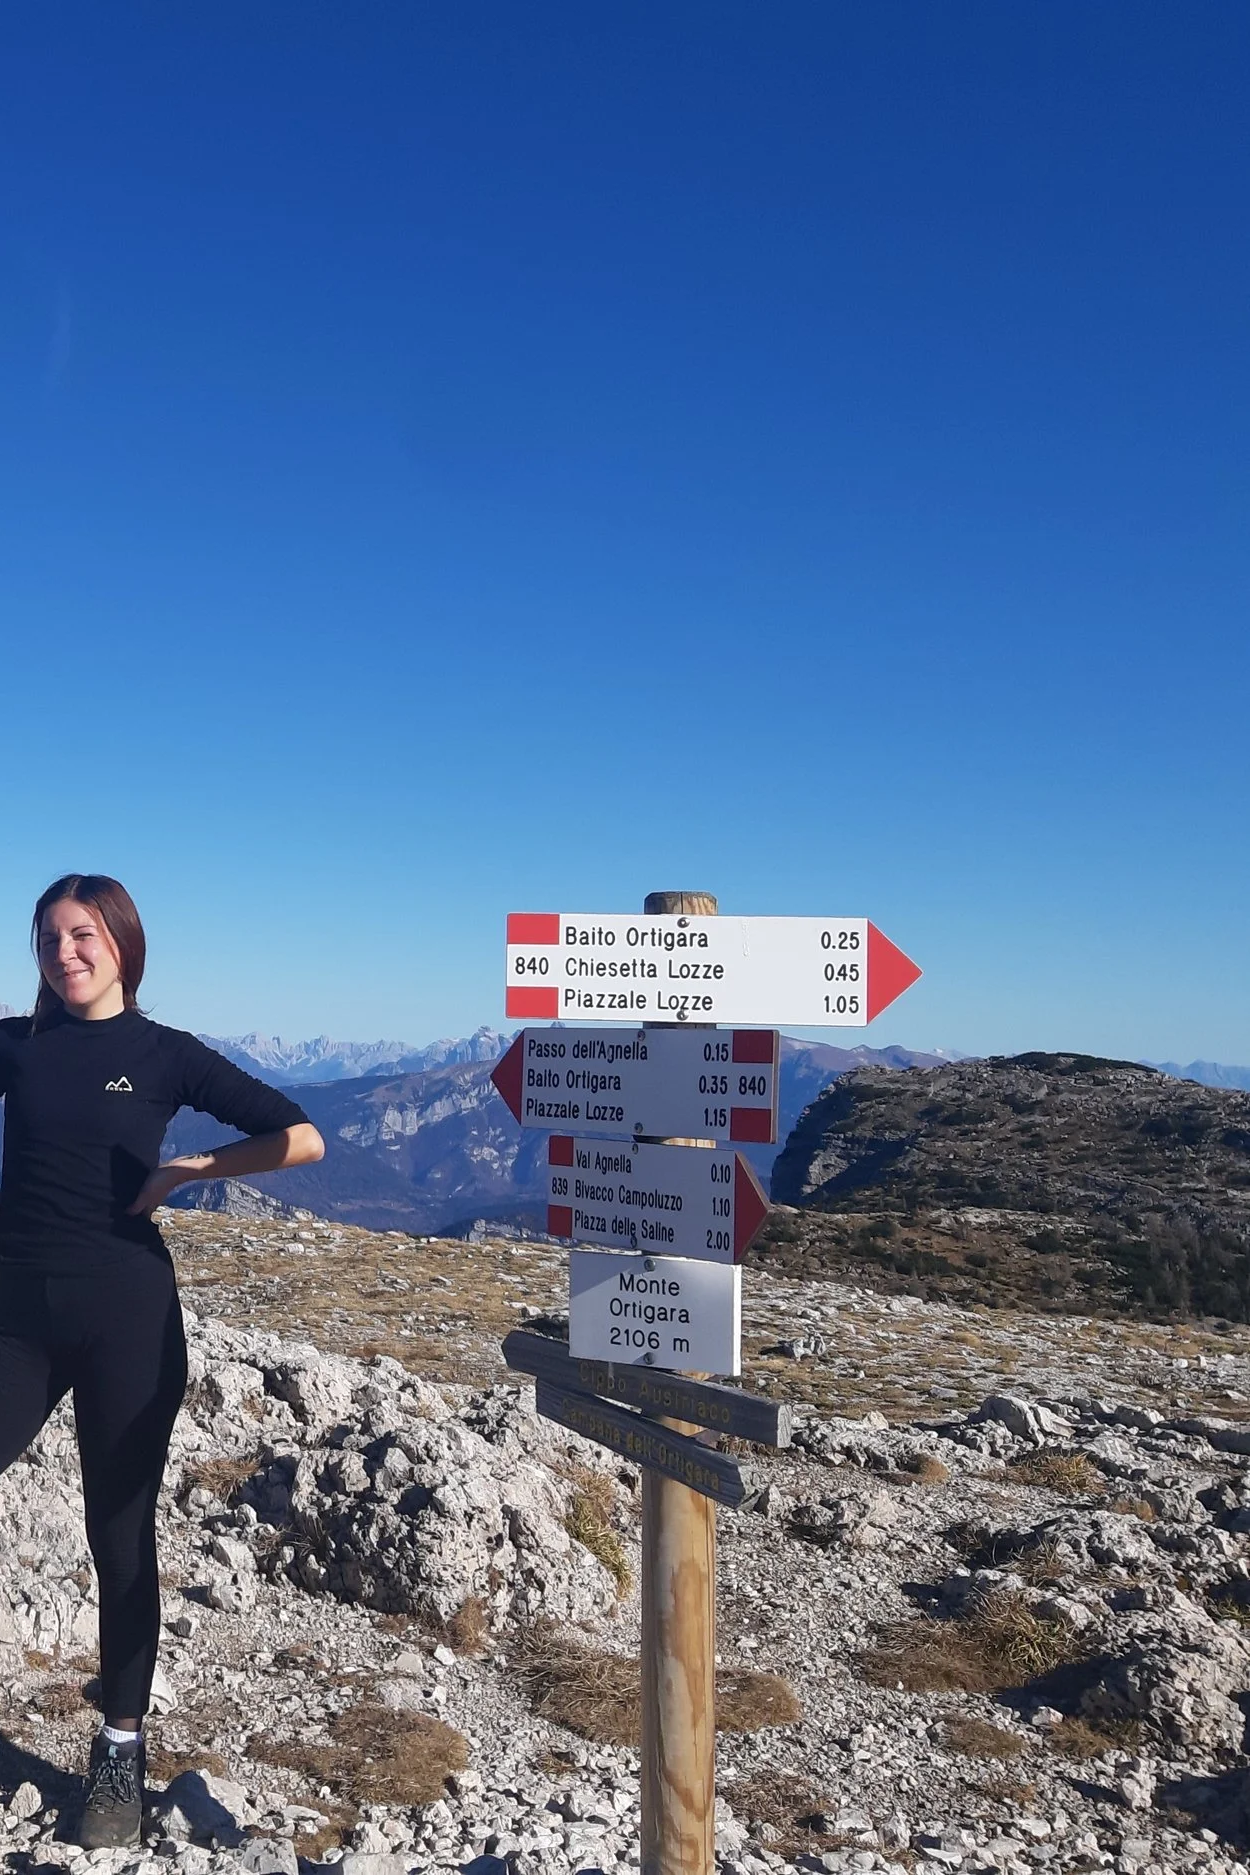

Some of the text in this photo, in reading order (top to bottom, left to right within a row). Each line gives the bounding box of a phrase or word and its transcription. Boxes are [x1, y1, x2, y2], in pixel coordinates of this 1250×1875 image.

[565, 927, 860, 952] Baito Ortigara 0.25
[515, 957, 860, 982] 840 Chiesetta Lozze 0.45
[564, 988, 860, 1014] Piazzale Lozze 1.05
[528, 1039, 729, 1063] Passo dell'Agnella 0.15
[527, 1068, 766, 1096] Baito Ortigara 0.35 840
[526, 1098, 727, 1127] Piazzale Lozze 1.15
[576, 1149, 731, 1184] Val Agnella 0.10
[551, 1177, 731, 1217] 839 Bivacco Campoluzzo 1.10
[574, 1209, 730, 1251] Piazza delle Saline 2.00
[619, 1273, 680, 1296] Monte
[609, 1298, 690, 1324] Ortigara
[610, 1327, 690, 1353] 2106 m
